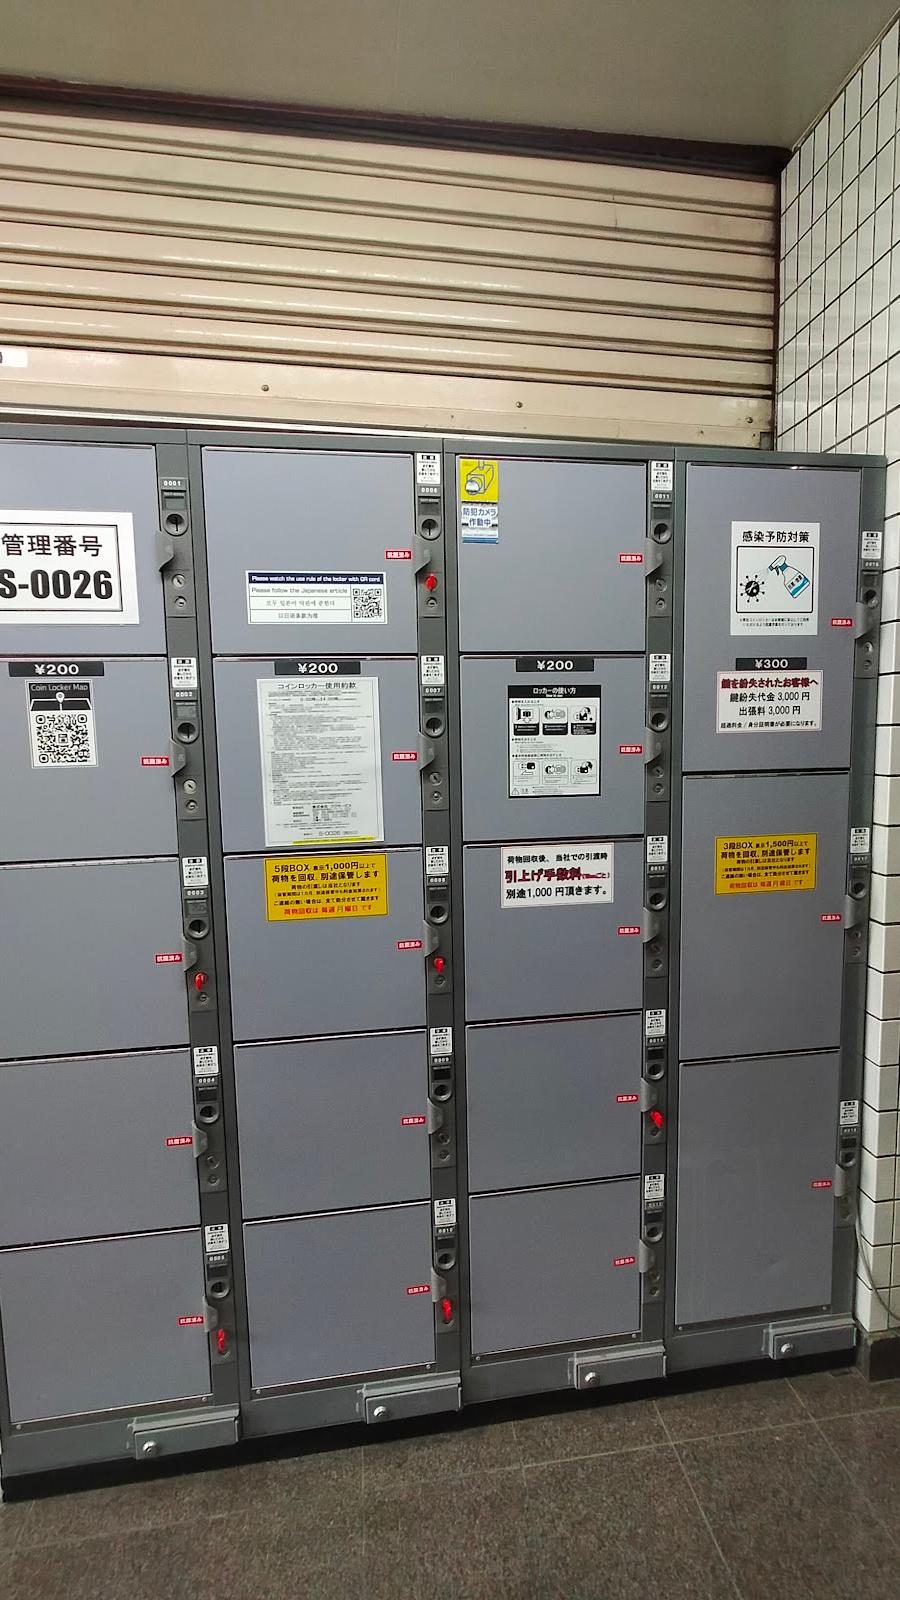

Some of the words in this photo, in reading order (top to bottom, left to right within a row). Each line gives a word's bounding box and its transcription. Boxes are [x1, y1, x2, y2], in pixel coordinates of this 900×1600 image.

[163, 479, 182, 487] 0001
[463, 508, 497, 516] 防犯カメラ
[469, 518, 491, 526] 作動中
[742, 531, 810, 542] 感染予防対策
[1, 533, 103, 557] 管理番号
[0, 568, 113, 600] S-0026
[298, 663, 338, 673] ¥200
[537, 660, 574, 670] ¥200
[755, 660, 788, 668] ¥300
[35, 664, 79, 675] ¥200
[72, 684, 88, 692] Map
[721, 678, 818, 688] 鍵を紛失されたお客様へ
[730, 692, 775, 702] 鍵紛失代金
[778, 692, 799, 701] 3,000
[802, 692, 810, 701] 円
[739, 706, 765, 716] 出張料
[768, 706, 790, 715] 3,000
[792, 706, 800, 714] 円
[507, 853, 608, 864] 荷物回収後、当社での引渡時
[274, 864, 310, 872] 5段BOX
[505, 867, 582, 883] 引上げ手数料
[506, 888, 552, 899] 別途1,000
[555, 885, 607, 896] 円頂きます。
